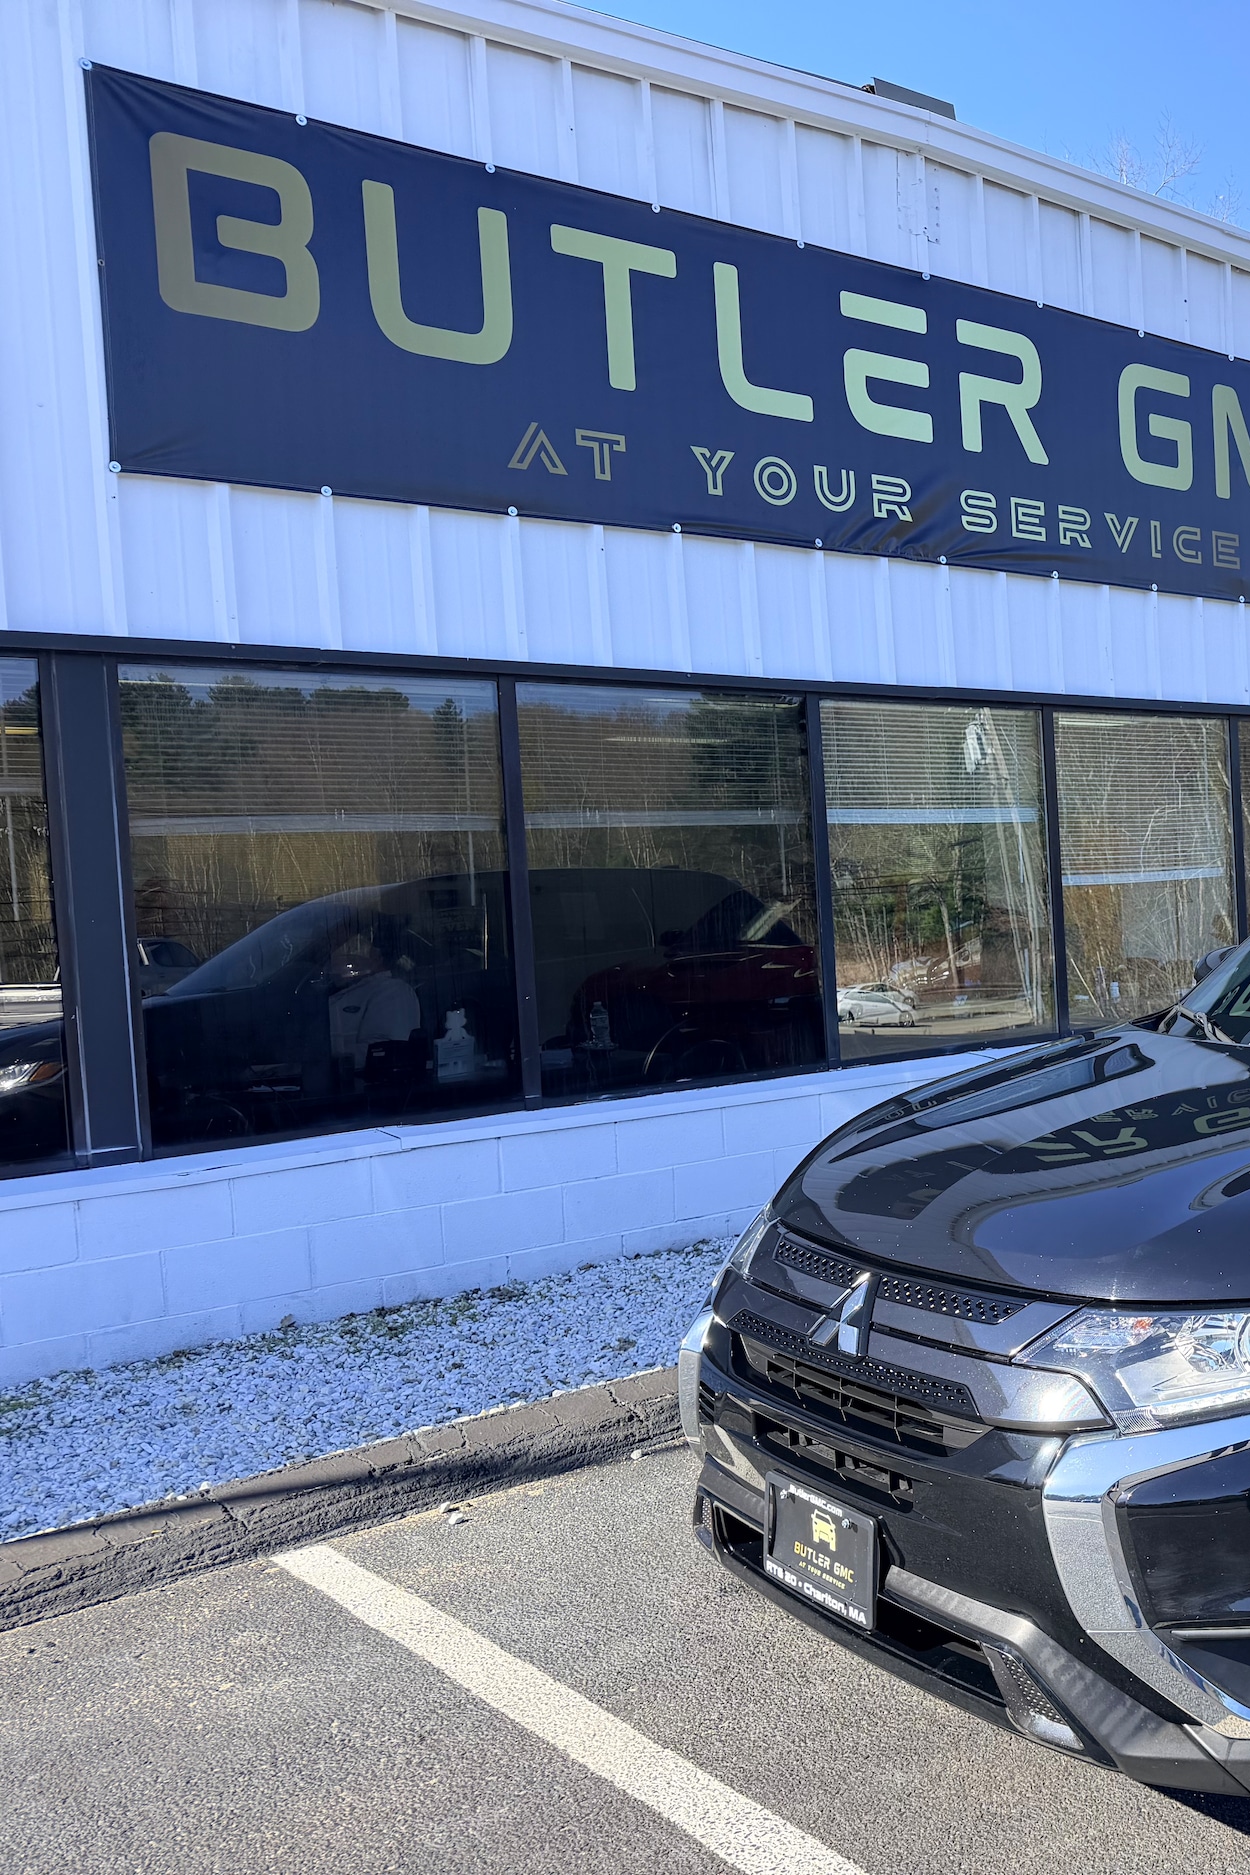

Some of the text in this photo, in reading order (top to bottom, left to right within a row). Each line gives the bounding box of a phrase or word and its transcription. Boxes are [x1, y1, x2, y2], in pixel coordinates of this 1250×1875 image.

[148, 131, 1049, 465] BUTLER
[507, 421, 1241, 569] AT YOUR SERVICE
[789, 1484, 843, 1517] ButlerGMC.com
[794, 1541, 855, 1583] BUTLER GMC
[822, 1573, 846, 1590] SERVICE
[784, 1571, 797, 1586] 20
[803, 1582, 847, 1615] Charlton,
[849, 1607, 867, 1625] MA
